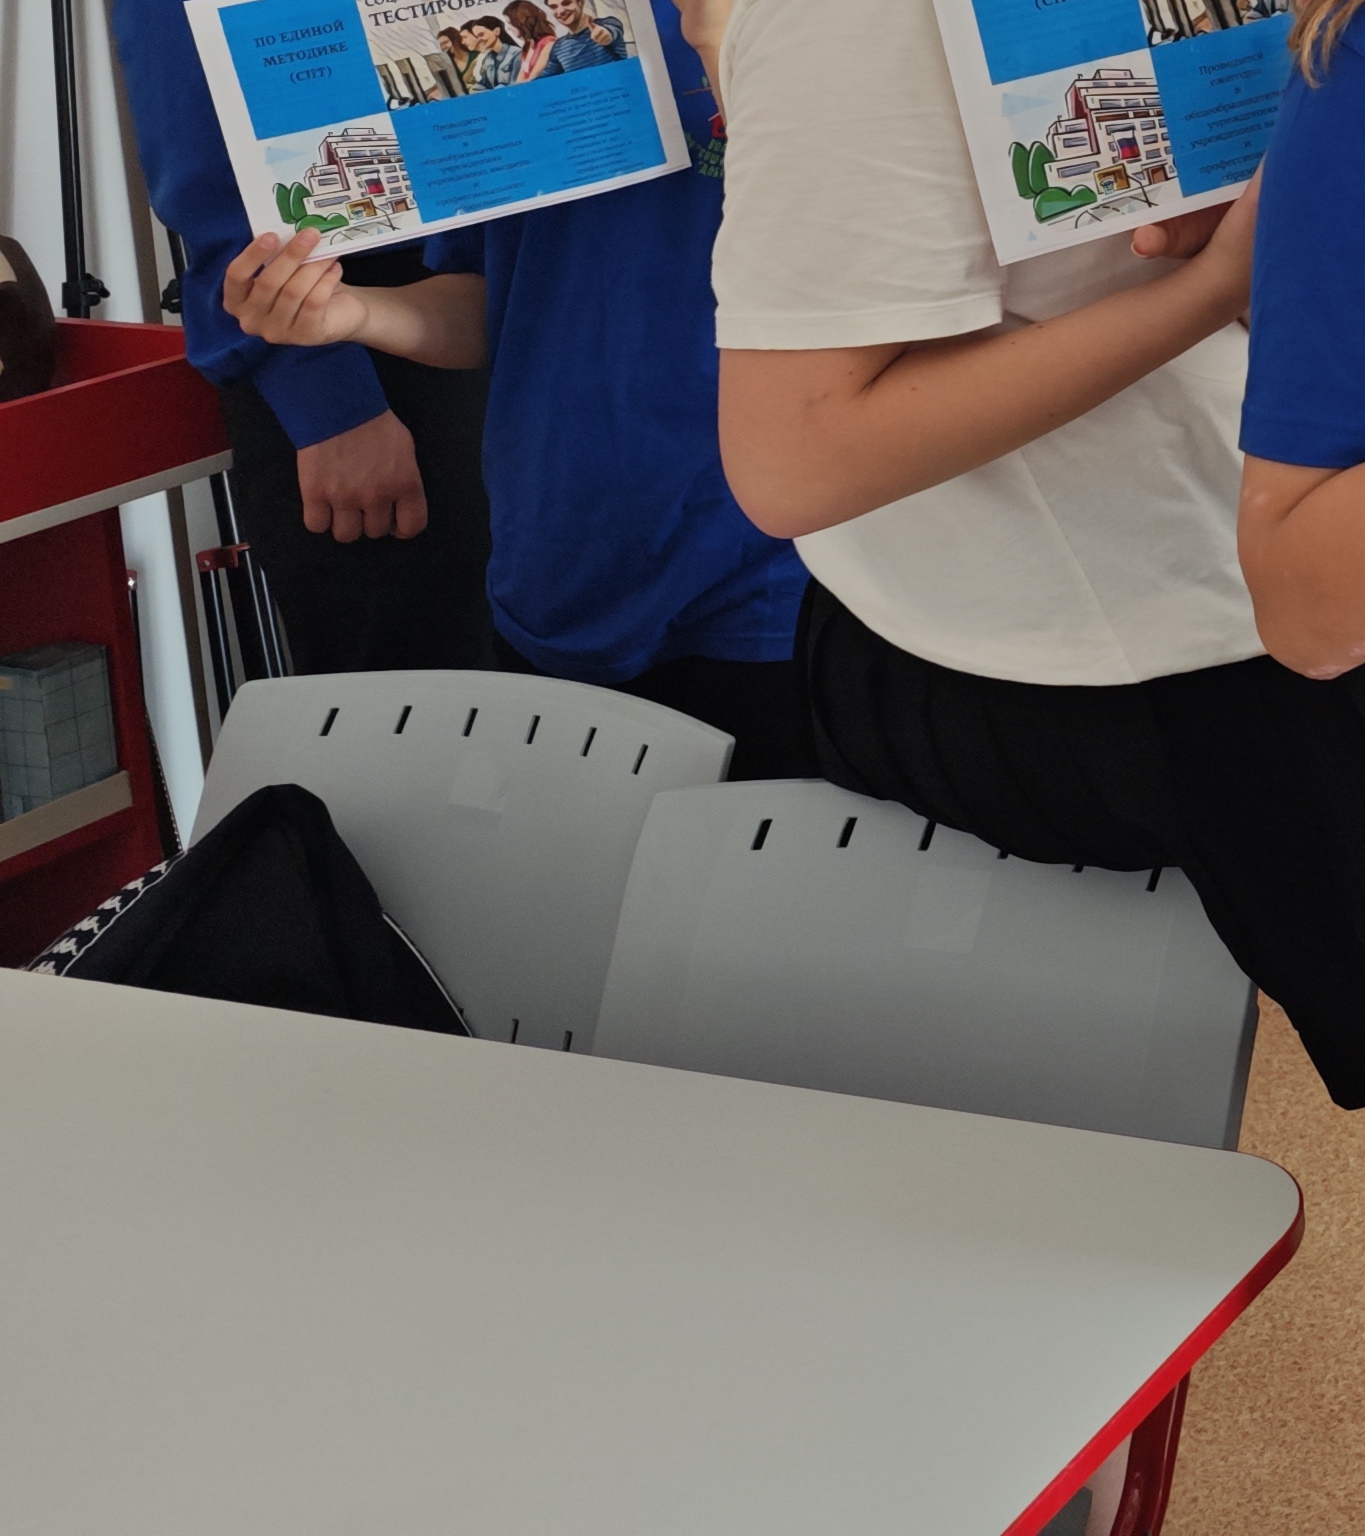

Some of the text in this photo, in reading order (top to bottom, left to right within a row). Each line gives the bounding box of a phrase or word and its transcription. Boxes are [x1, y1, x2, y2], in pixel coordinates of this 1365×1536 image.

[253, 19, 345, 48] ПО ЕДИНОЙ
[262, 40, 349, 67] МЕТОДИКЕ
[289, 65, 333, 84] (СПТ)
